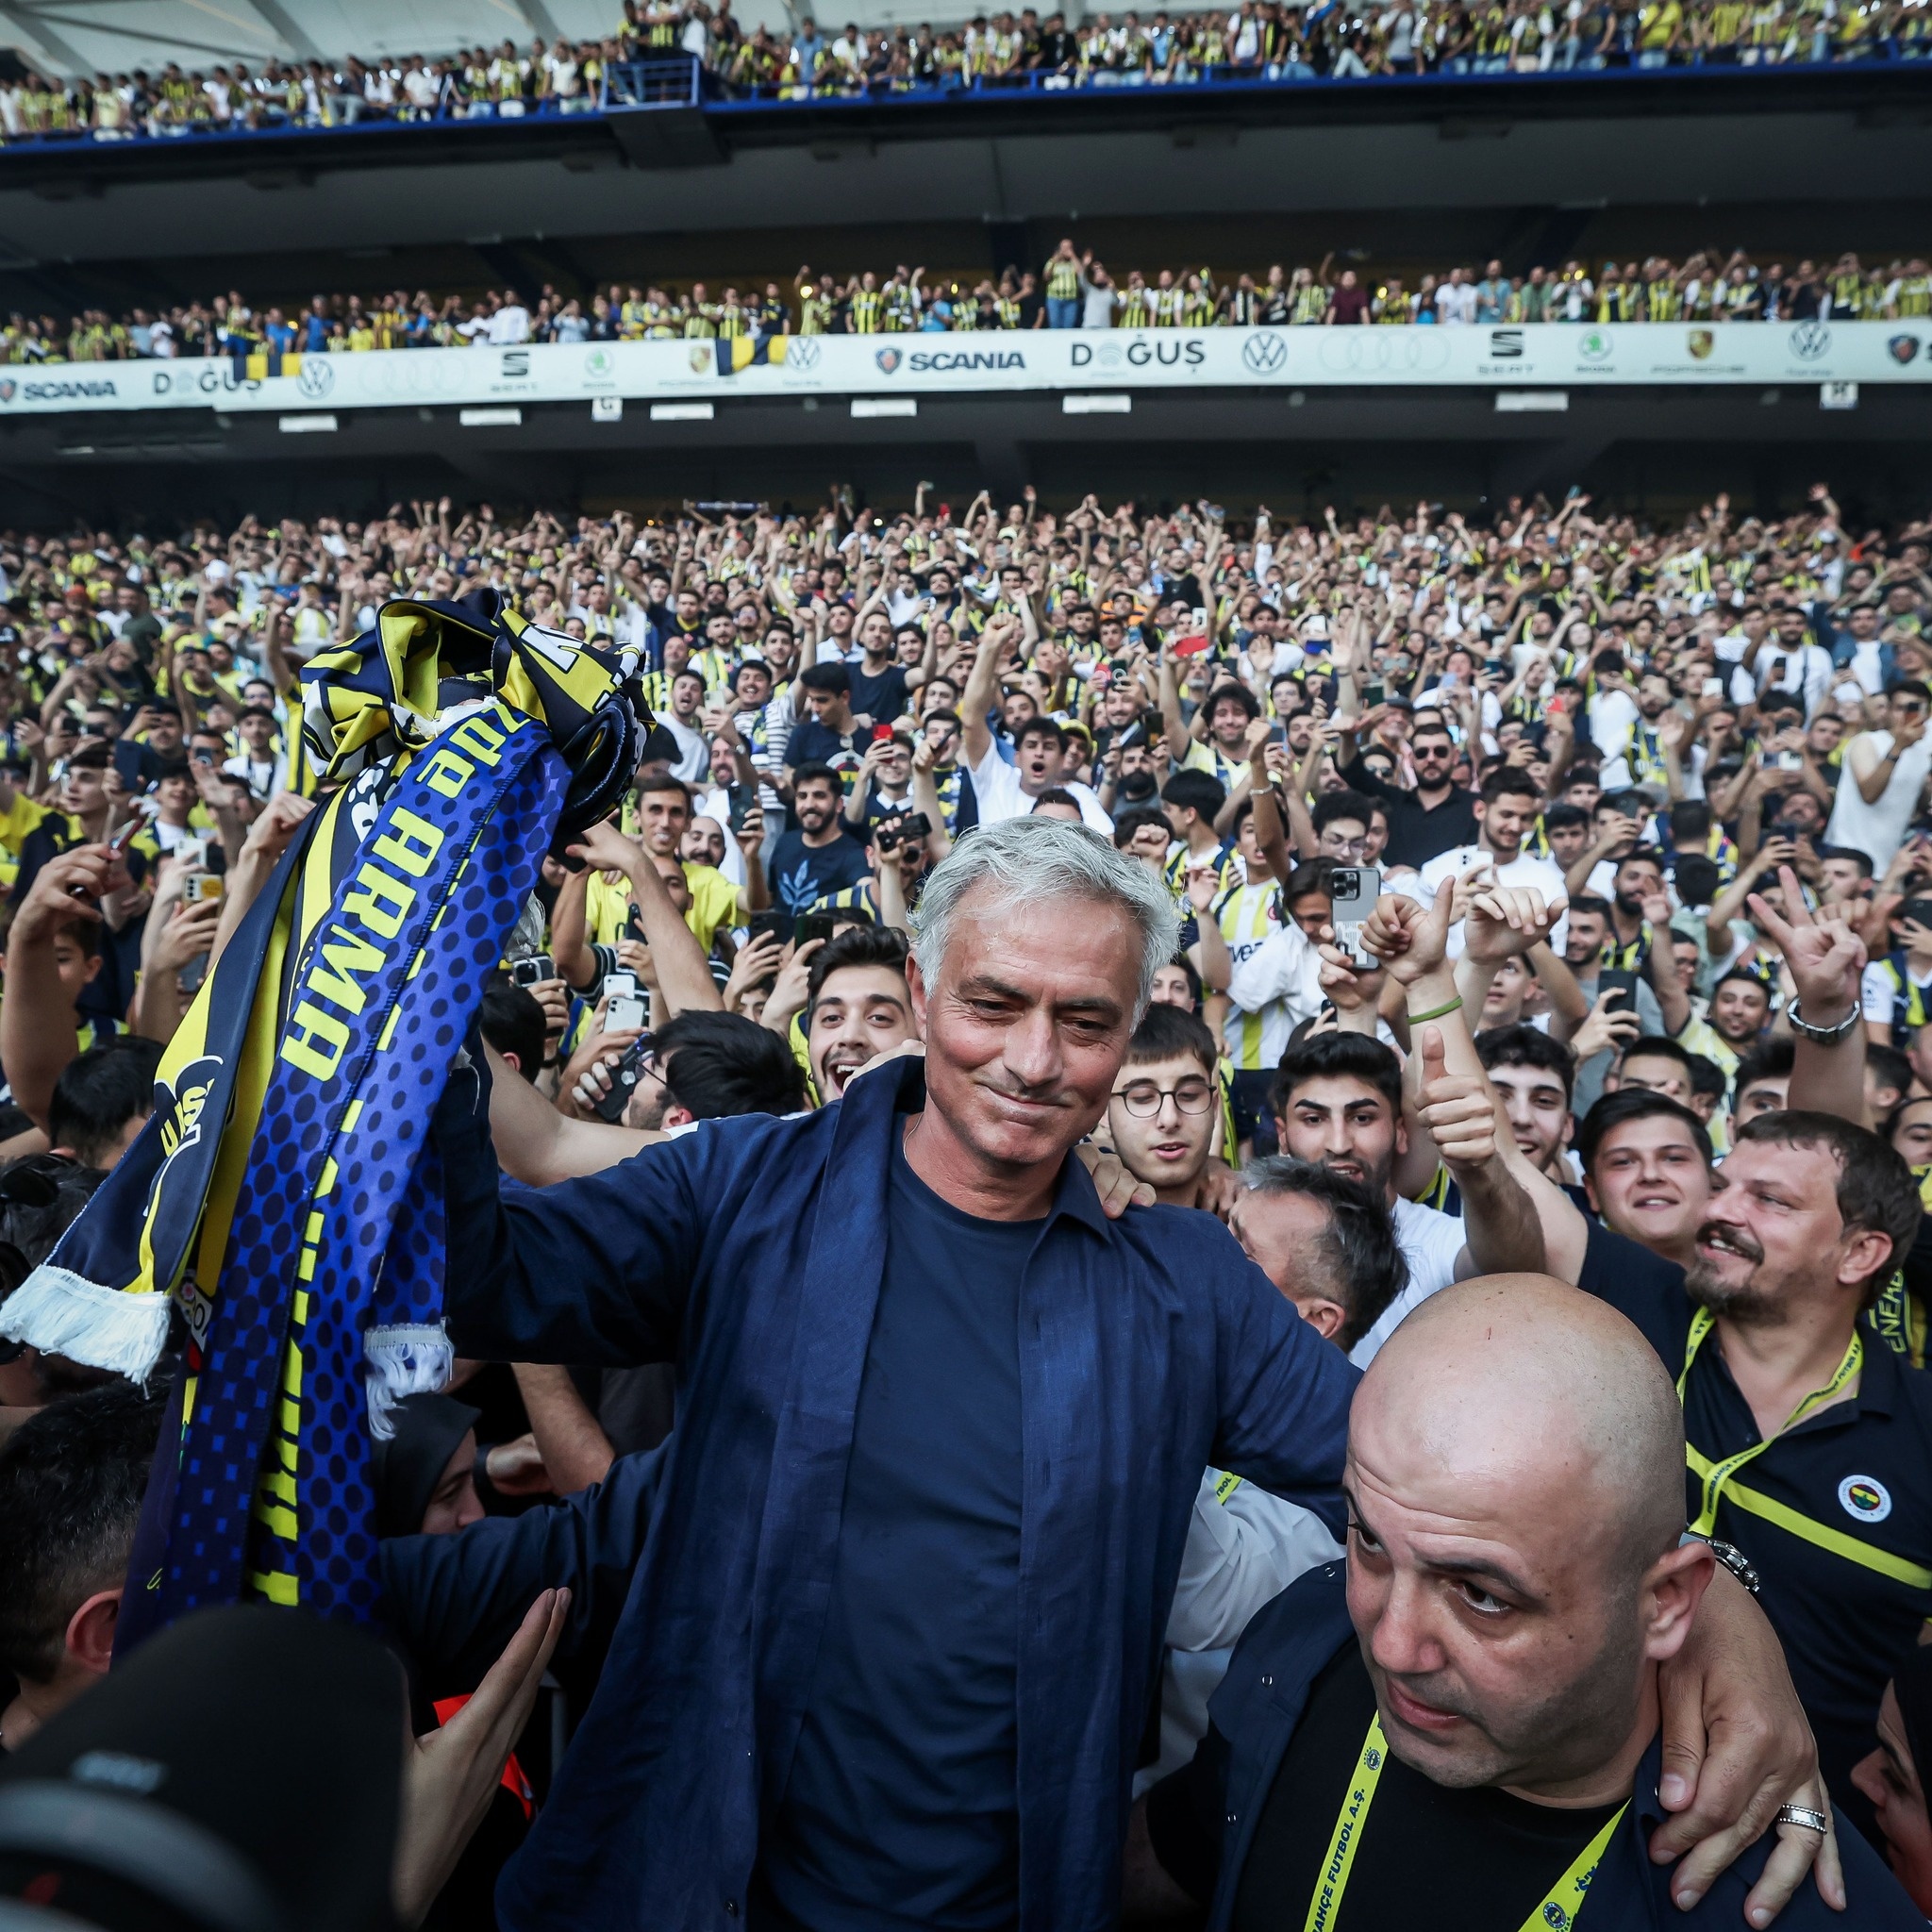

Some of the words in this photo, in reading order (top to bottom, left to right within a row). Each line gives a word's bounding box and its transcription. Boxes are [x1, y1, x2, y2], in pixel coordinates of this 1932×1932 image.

[909, 352, 1026, 371] SCANIA
[279, 806, 445, 1082] ARMA
[1326, 1822, 1354, 1885] FUTBOL
[1348, 1789, 1366, 1819] A.Ş.
